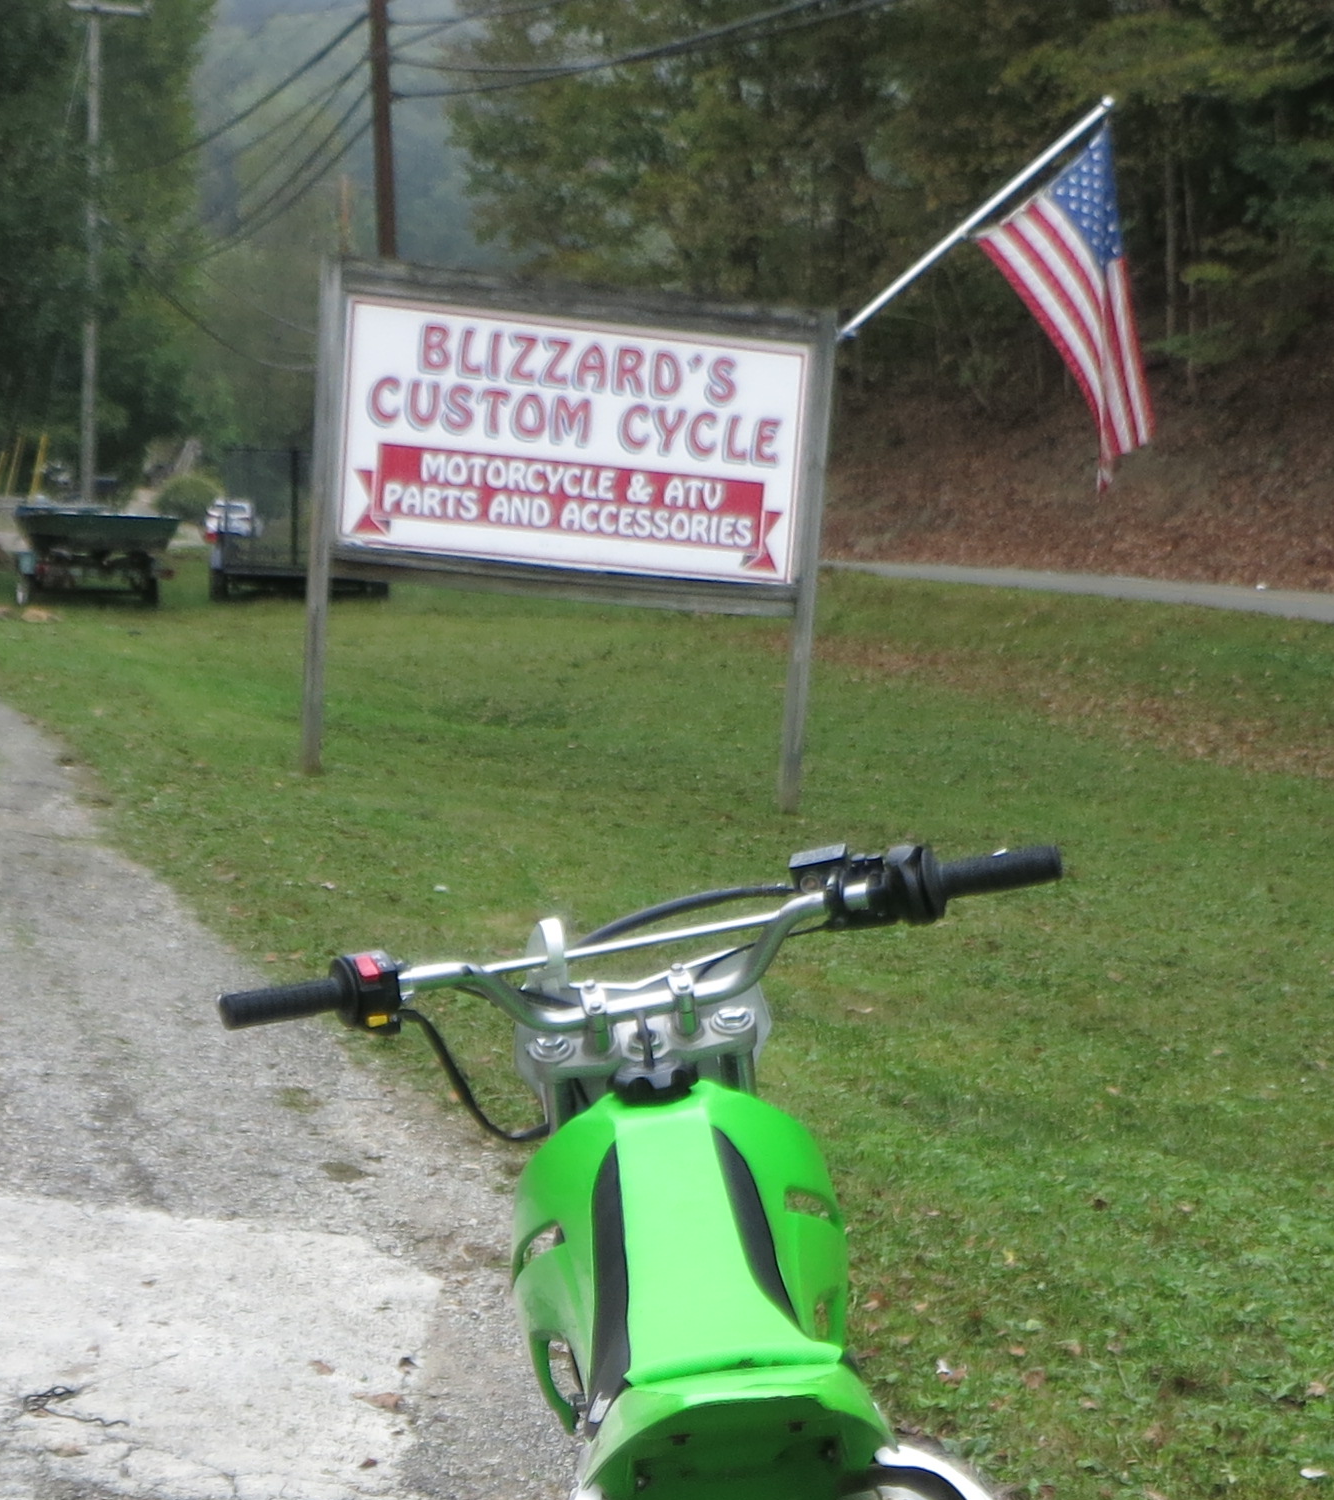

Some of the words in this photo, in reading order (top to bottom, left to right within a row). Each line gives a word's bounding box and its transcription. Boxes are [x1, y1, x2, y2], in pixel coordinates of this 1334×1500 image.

[421, 324, 737, 405] BLIZZARD'S
[369, 377, 591, 447] CUSTOM
[620, 404, 782, 465] CYCLE
[384, 484, 477, 521] PARTS
[489, 495, 551, 529] AND
[561, 504, 753, 547] ACCESSORIES
[422, 455, 615, 499] MOTORCYCLE
[628, 475, 652, 503] &
[665, 480, 723, 509] ATV
